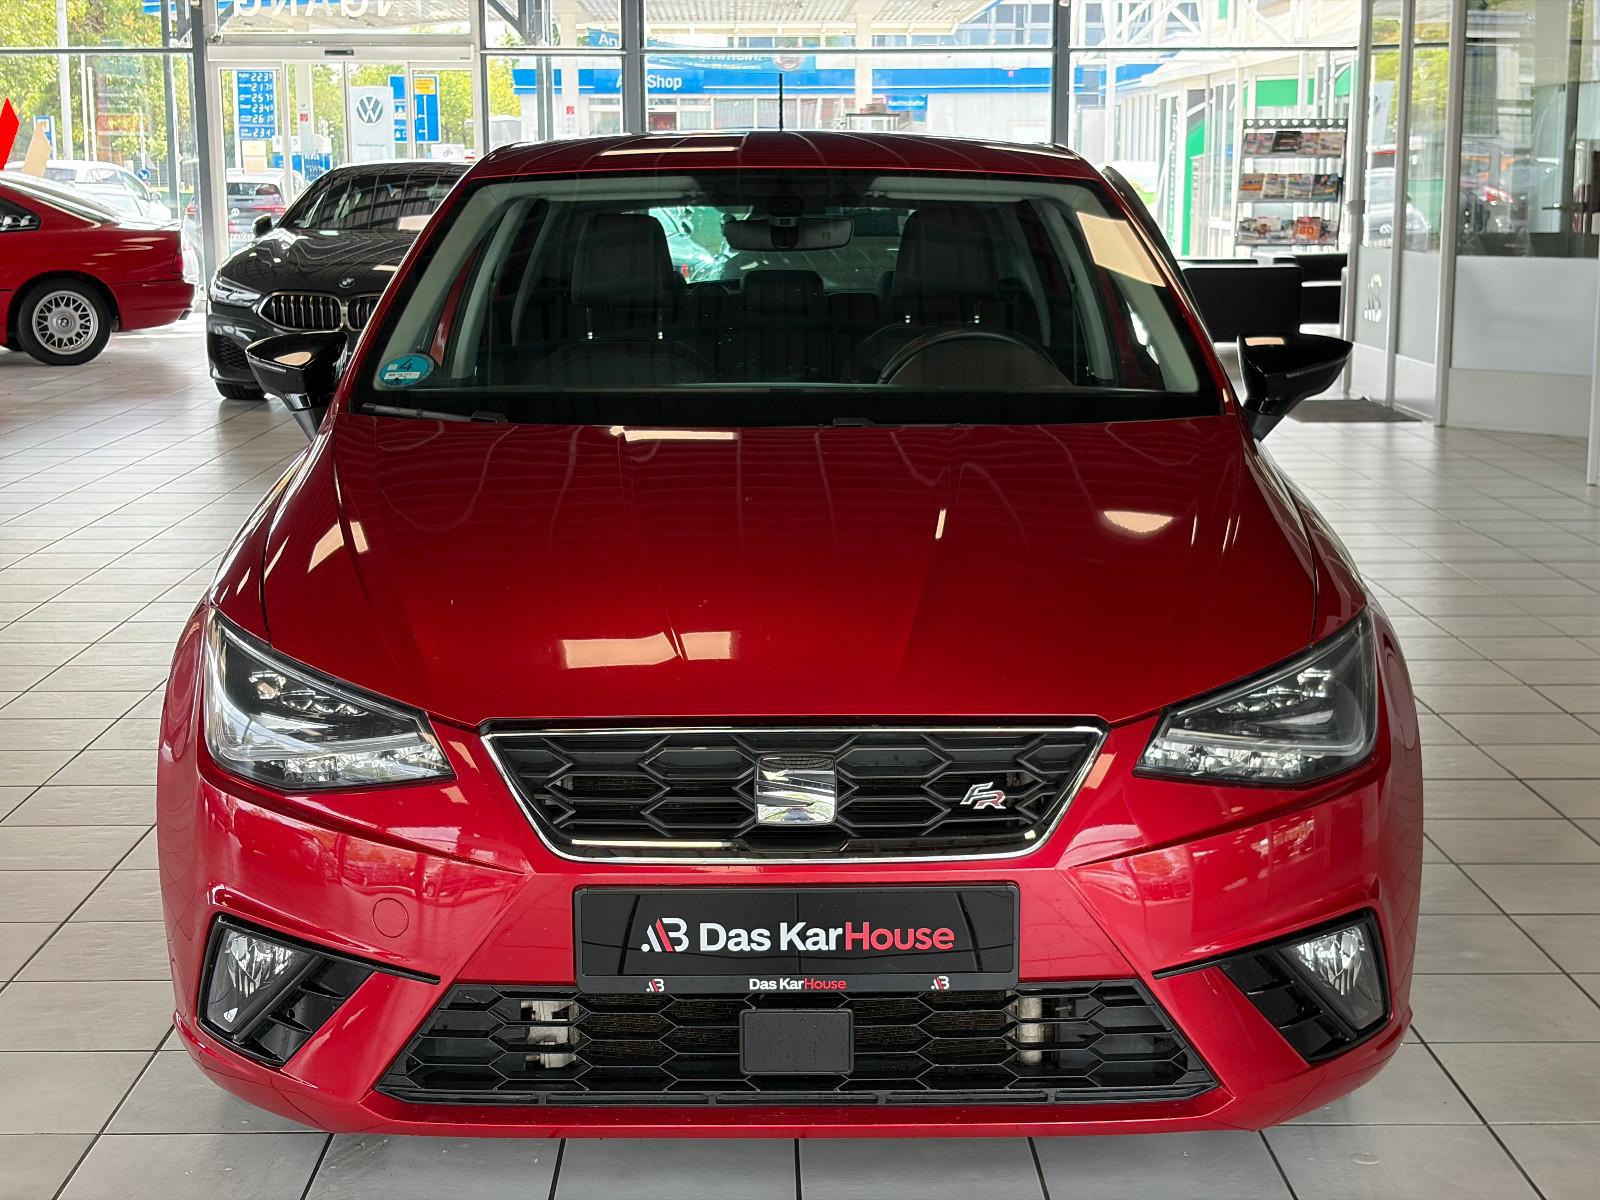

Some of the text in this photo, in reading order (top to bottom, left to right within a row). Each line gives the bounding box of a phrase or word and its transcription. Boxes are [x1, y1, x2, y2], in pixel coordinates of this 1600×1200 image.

[647, 73, 683, 91] Shop
[399, 358, 414, 371] 4
[959, 781, 1007, 810] FR
[699, 922, 772, 952] Das
[779, 921, 956, 951] KarHouse
[748, 978, 847, 990] Das KarHouse
